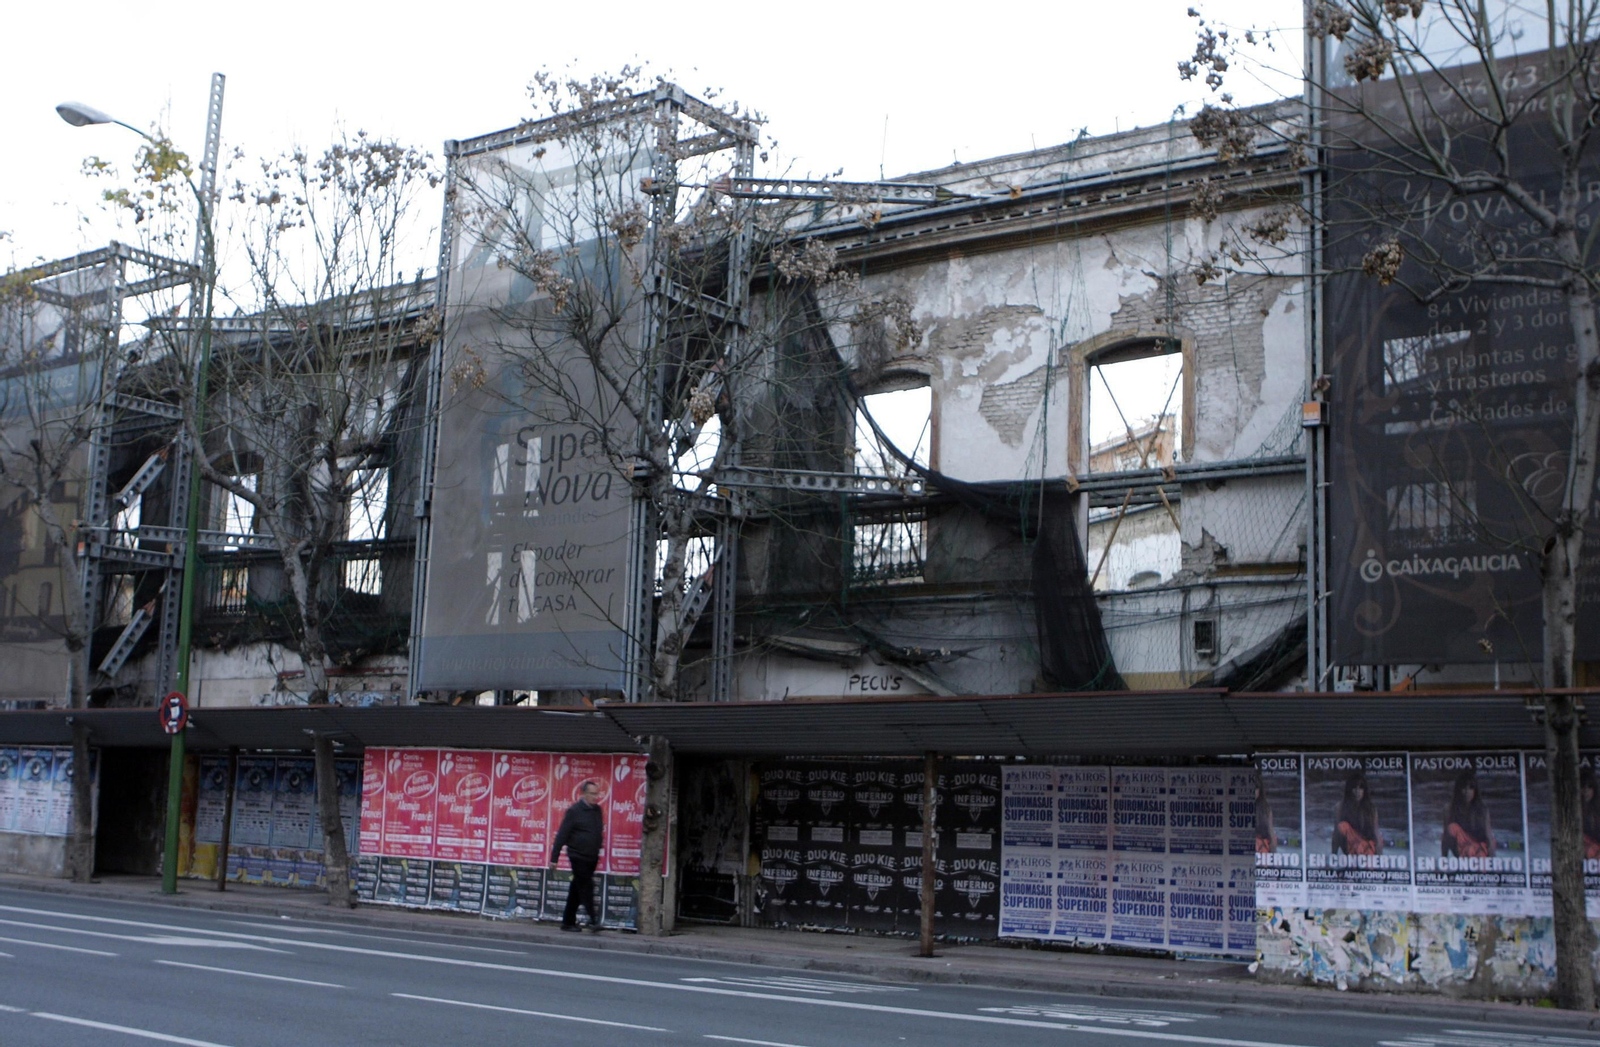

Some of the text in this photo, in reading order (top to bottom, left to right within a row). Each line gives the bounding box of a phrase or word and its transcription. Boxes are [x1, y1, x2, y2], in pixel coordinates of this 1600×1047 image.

[1428, 288, 1562, 318] 84 Viviendas
[1477, 319, 1487, 334] 2
[1494, 318, 1506, 338] y
[1514, 315, 1524, 330] 3
[1430, 342, 1558, 374] 3 plantas de
[1448, 368, 1546, 391] trasteros
[1541, 396, 1567, 416] de
[535, 568, 615, 590] comprar
[848, 674, 904, 692] PECU'S
[1261, 758, 1298, 770] SOLER
[1308, 757, 1403, 770] PASTORA SOLER
[1414, 757, 1472, 770] PASTORA
[1476, 756, 1516, 769] SOLER
[1022, 771, 1052, 780] KIROS
[1076, 772, 1106, 782] KIROS
[1132, 773, 1164, 782] KIROS
[1188, 774, 1222, 784] KIROS
[1004, 796, 1053, 808] QUIROMASAJE
[1058, 799, 1108, 811] QUIROMASAJE
[1114, 800, 1166, 812] QUIROMASAJE
[1170, 801, 1224, 814] QUIROMASAJE
[1004, 809, 1053, 822] SUPERIOR
[1058, 812, 1108, 824] SUPERIOR
[1114, 812, 1166, 826] SUPERIOR
[1170, 814, 1224, 828] SUPERIOR
[1021, 858, 1052, 867] KIROS
[1075, 860, 1106, 870] KIROS
[1256, 852, 1300, 866] CIERTO
[1309, 853, 1408, 868] EN CONCIERTO
[1417, 856, 1522, 872] EN CONCIERTO
[1131, 862, 1164, 874] KIROS
[1189, 866, 1222, 876] KIROS
[1280, 870, 1302, 878] FIBES
[1308, 870, 1338, 878] SEVILLA
[1416, 874, 1524, 883] SEVILLA AUDITORIO FIBES
[1004, 883, 1052, 896] QUIROMASAJE
[1057, 885, 1108, 900] QUIROMASAJE
[1112, 888, 1165, 904] QUIROMASAJE
[1004, 896, 1052, 910] SUPERIOR
[1057, 898, 1107, 913] SUPERIOR
[1170, 892, 1224, 908] QUIROMASAJE
[1112, 902, 1165, 918] SUPERIOR
[1170, 906, 1224, 921] SUPERIOR
